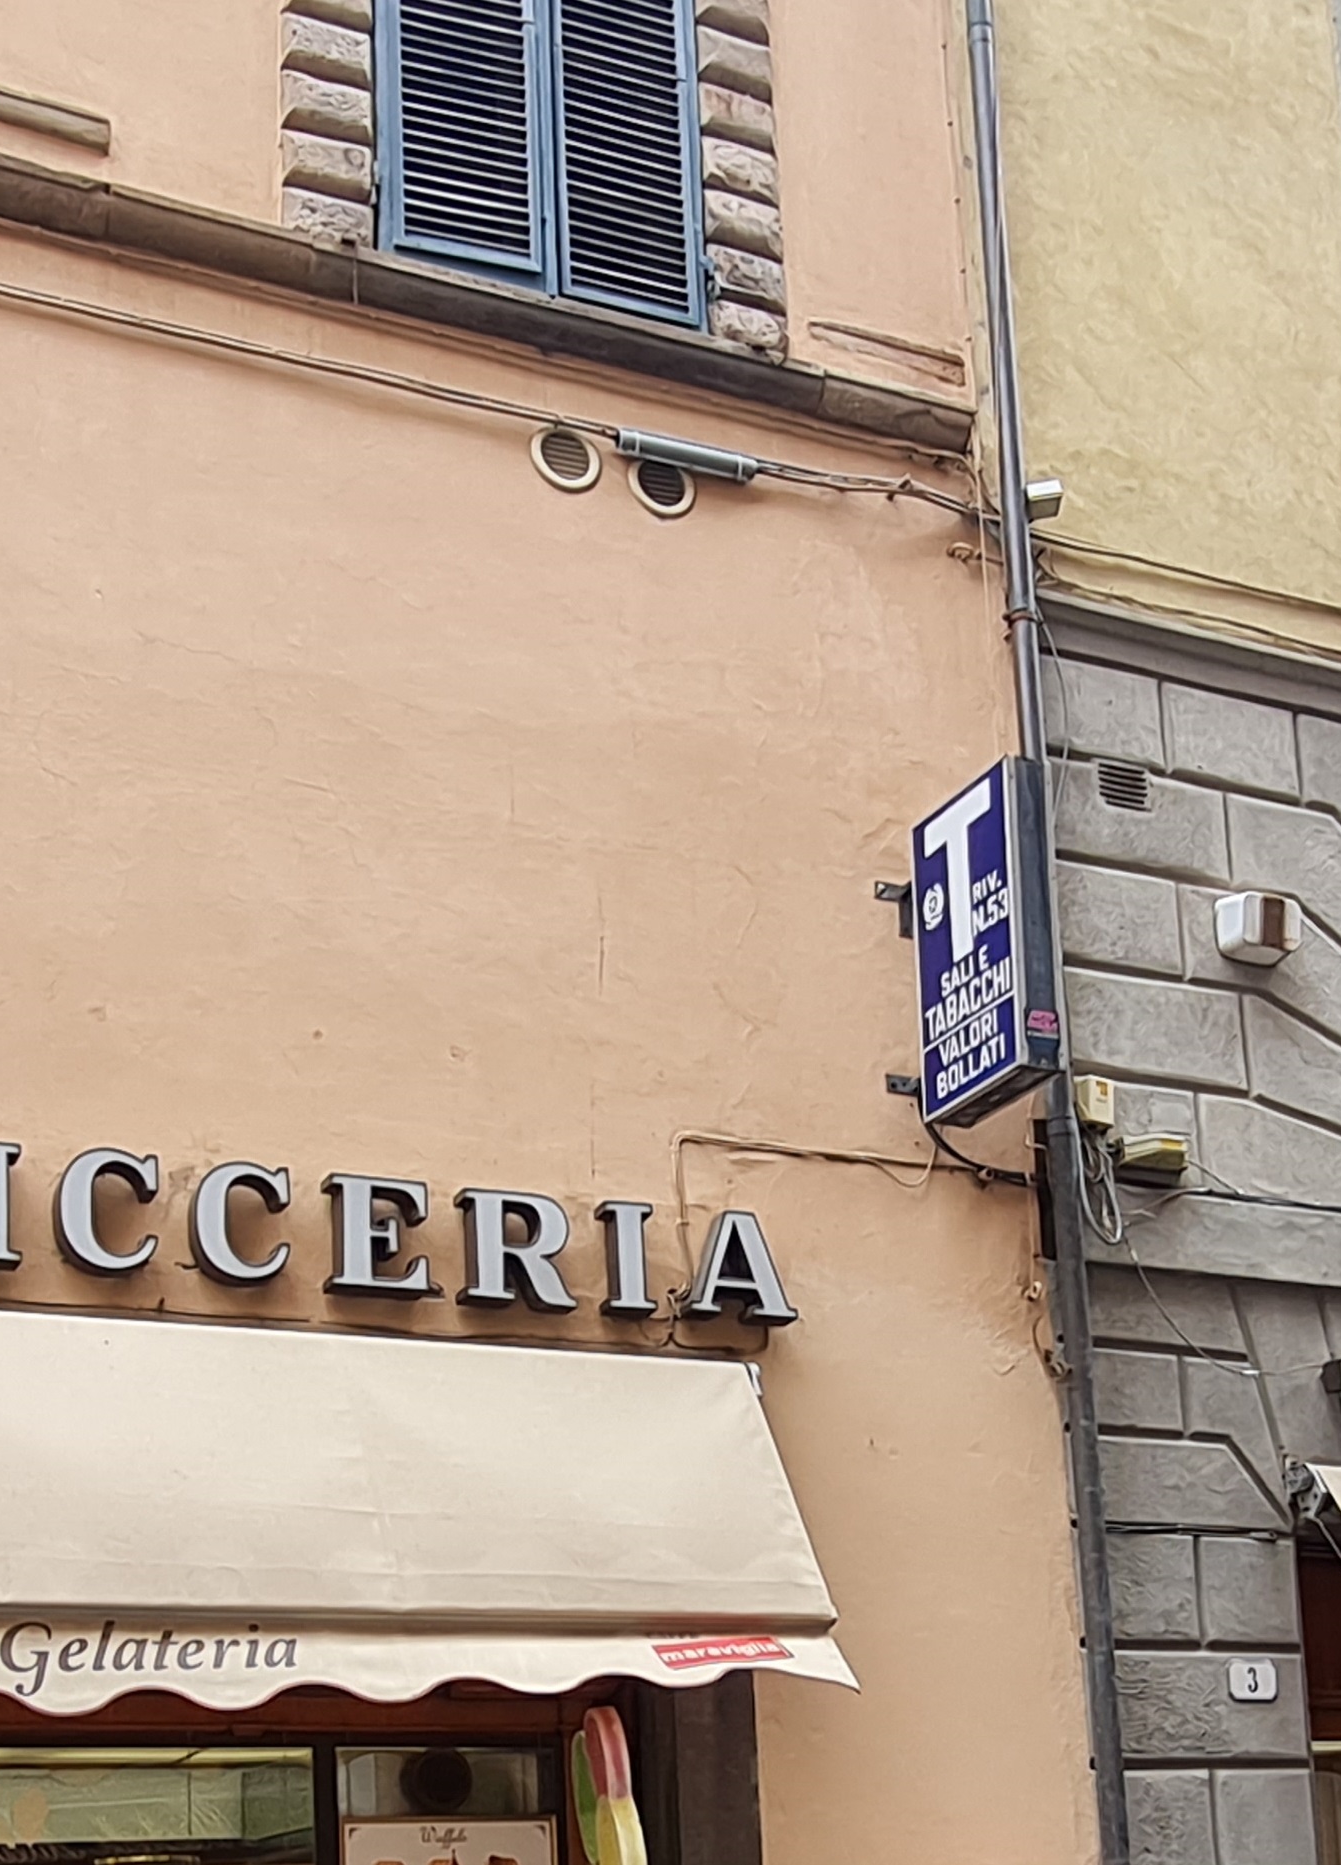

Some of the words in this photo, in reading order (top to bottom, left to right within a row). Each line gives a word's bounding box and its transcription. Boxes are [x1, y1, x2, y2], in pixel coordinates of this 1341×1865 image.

[924, 778, 991, 964] T
[972, 869, 1003, 905] RIV.
[924, 955, 1011, 1042] TABACCHI
[940, 954, 975, 999] SALI
[978, 943, 990, 971] E
[936, 1032, 1006, 1100] BOLLATI
[938, 1007, 999, 1068] VALORI
[0, 1619, 299, 1697] Gelateria
[1247, 1666, 1259, 1694] 3
